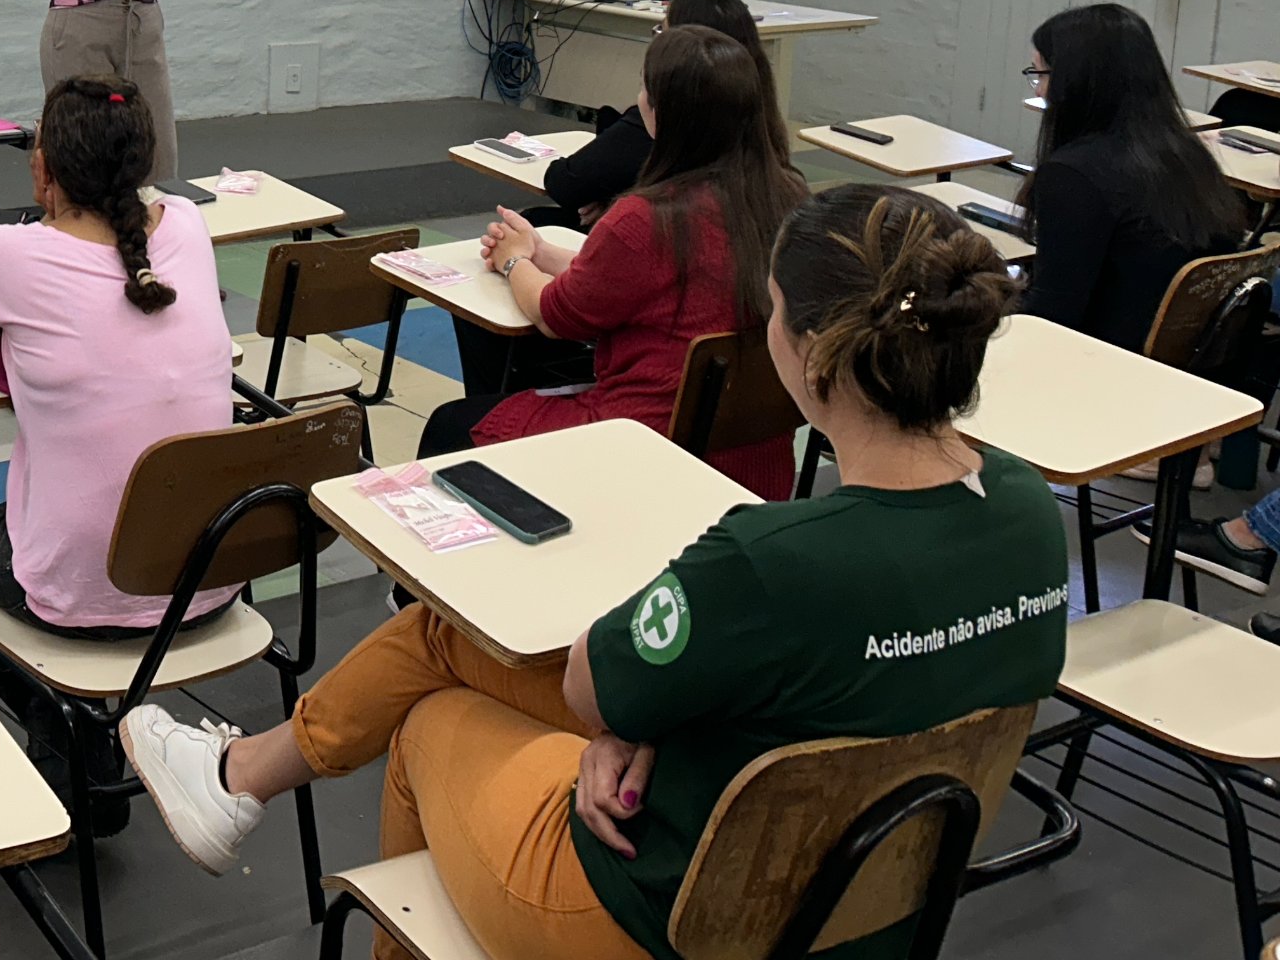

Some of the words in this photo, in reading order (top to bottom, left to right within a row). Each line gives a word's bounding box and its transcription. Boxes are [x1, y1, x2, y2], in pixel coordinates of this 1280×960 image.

[673, 586, 687, 615] CIPA
[864, 631, 946, 660] Acidente
[949, 617, 974, 645] não
[977, 606, 1016, 636] avisa.
